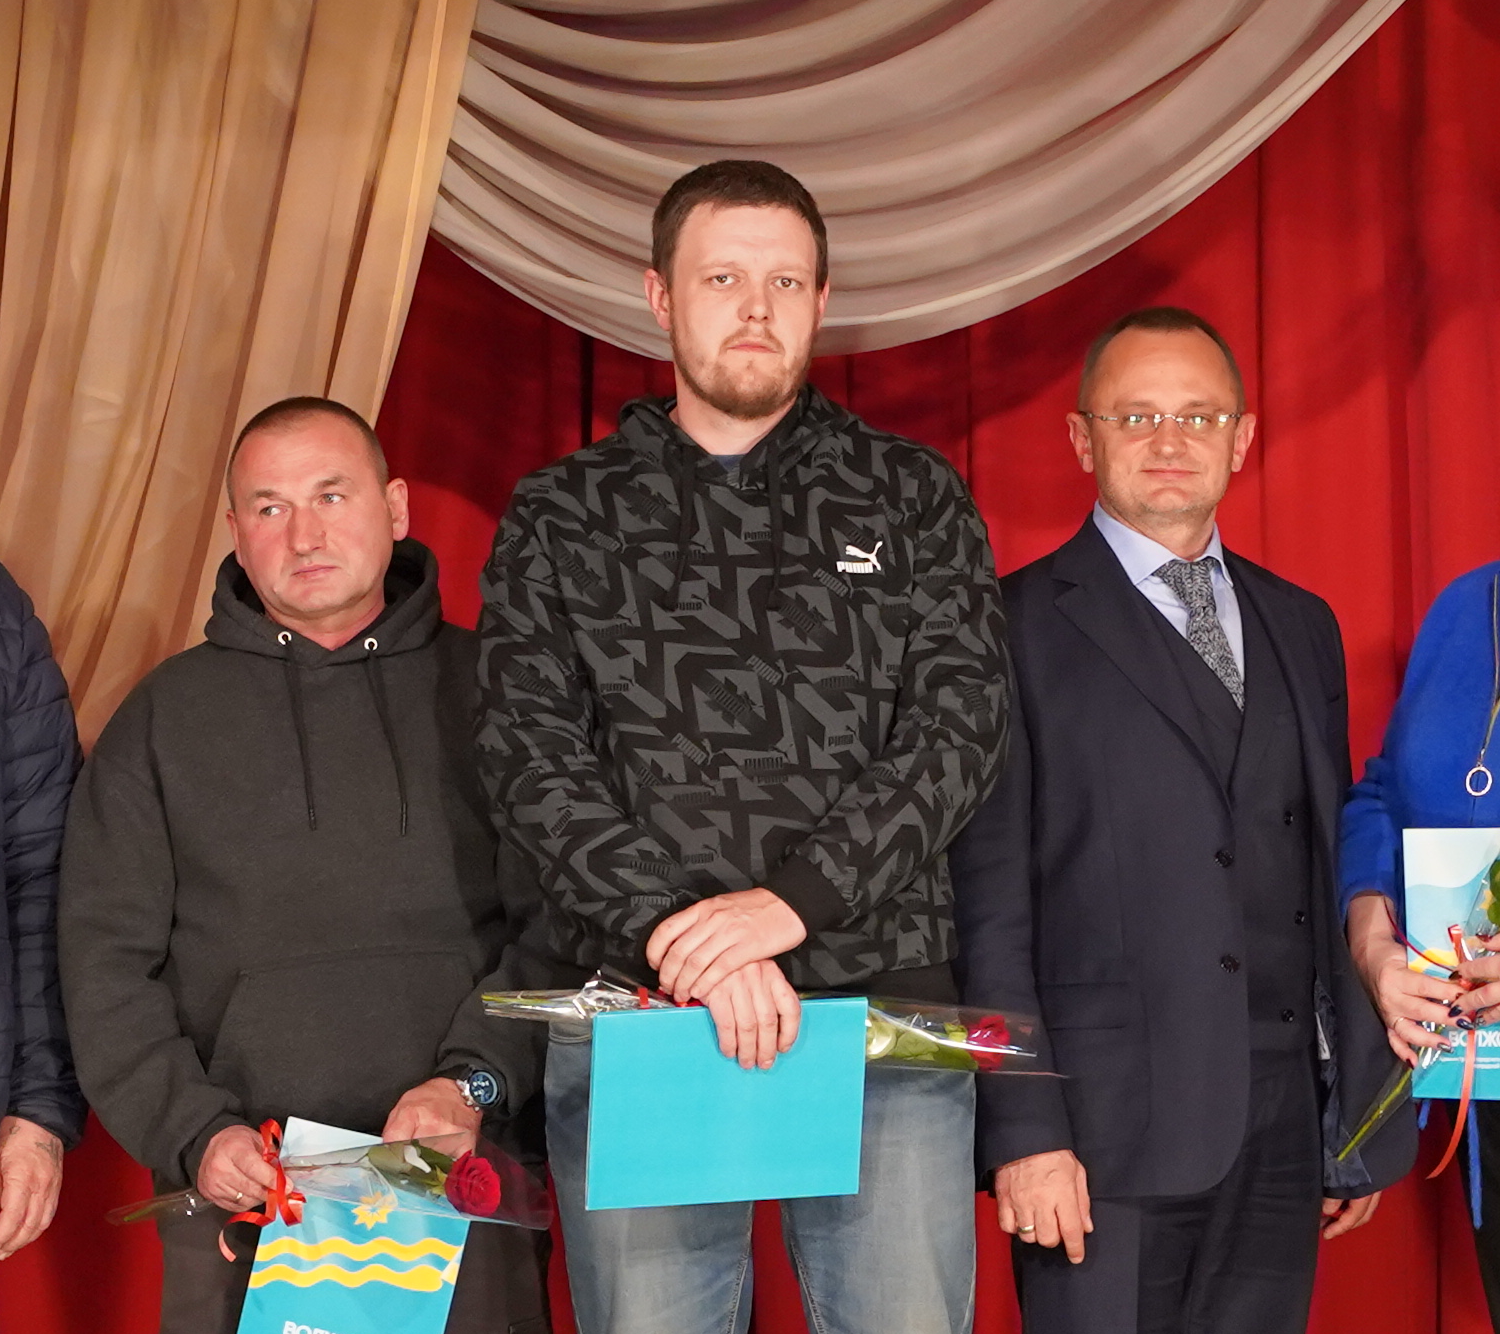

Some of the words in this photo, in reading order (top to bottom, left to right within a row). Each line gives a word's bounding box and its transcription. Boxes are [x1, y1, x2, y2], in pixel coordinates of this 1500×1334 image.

[836, 561, 874, 573] PUMA
[813, 568, 848, 596] PUMA
[746, 655, 780, 684] PUMA
[600, 683, 629, 692] PUMA
[828, 735, 854, 746] PUMA
[671, 733, 706, 765] PUMA
[684, 853, 714, 864] PUMA
